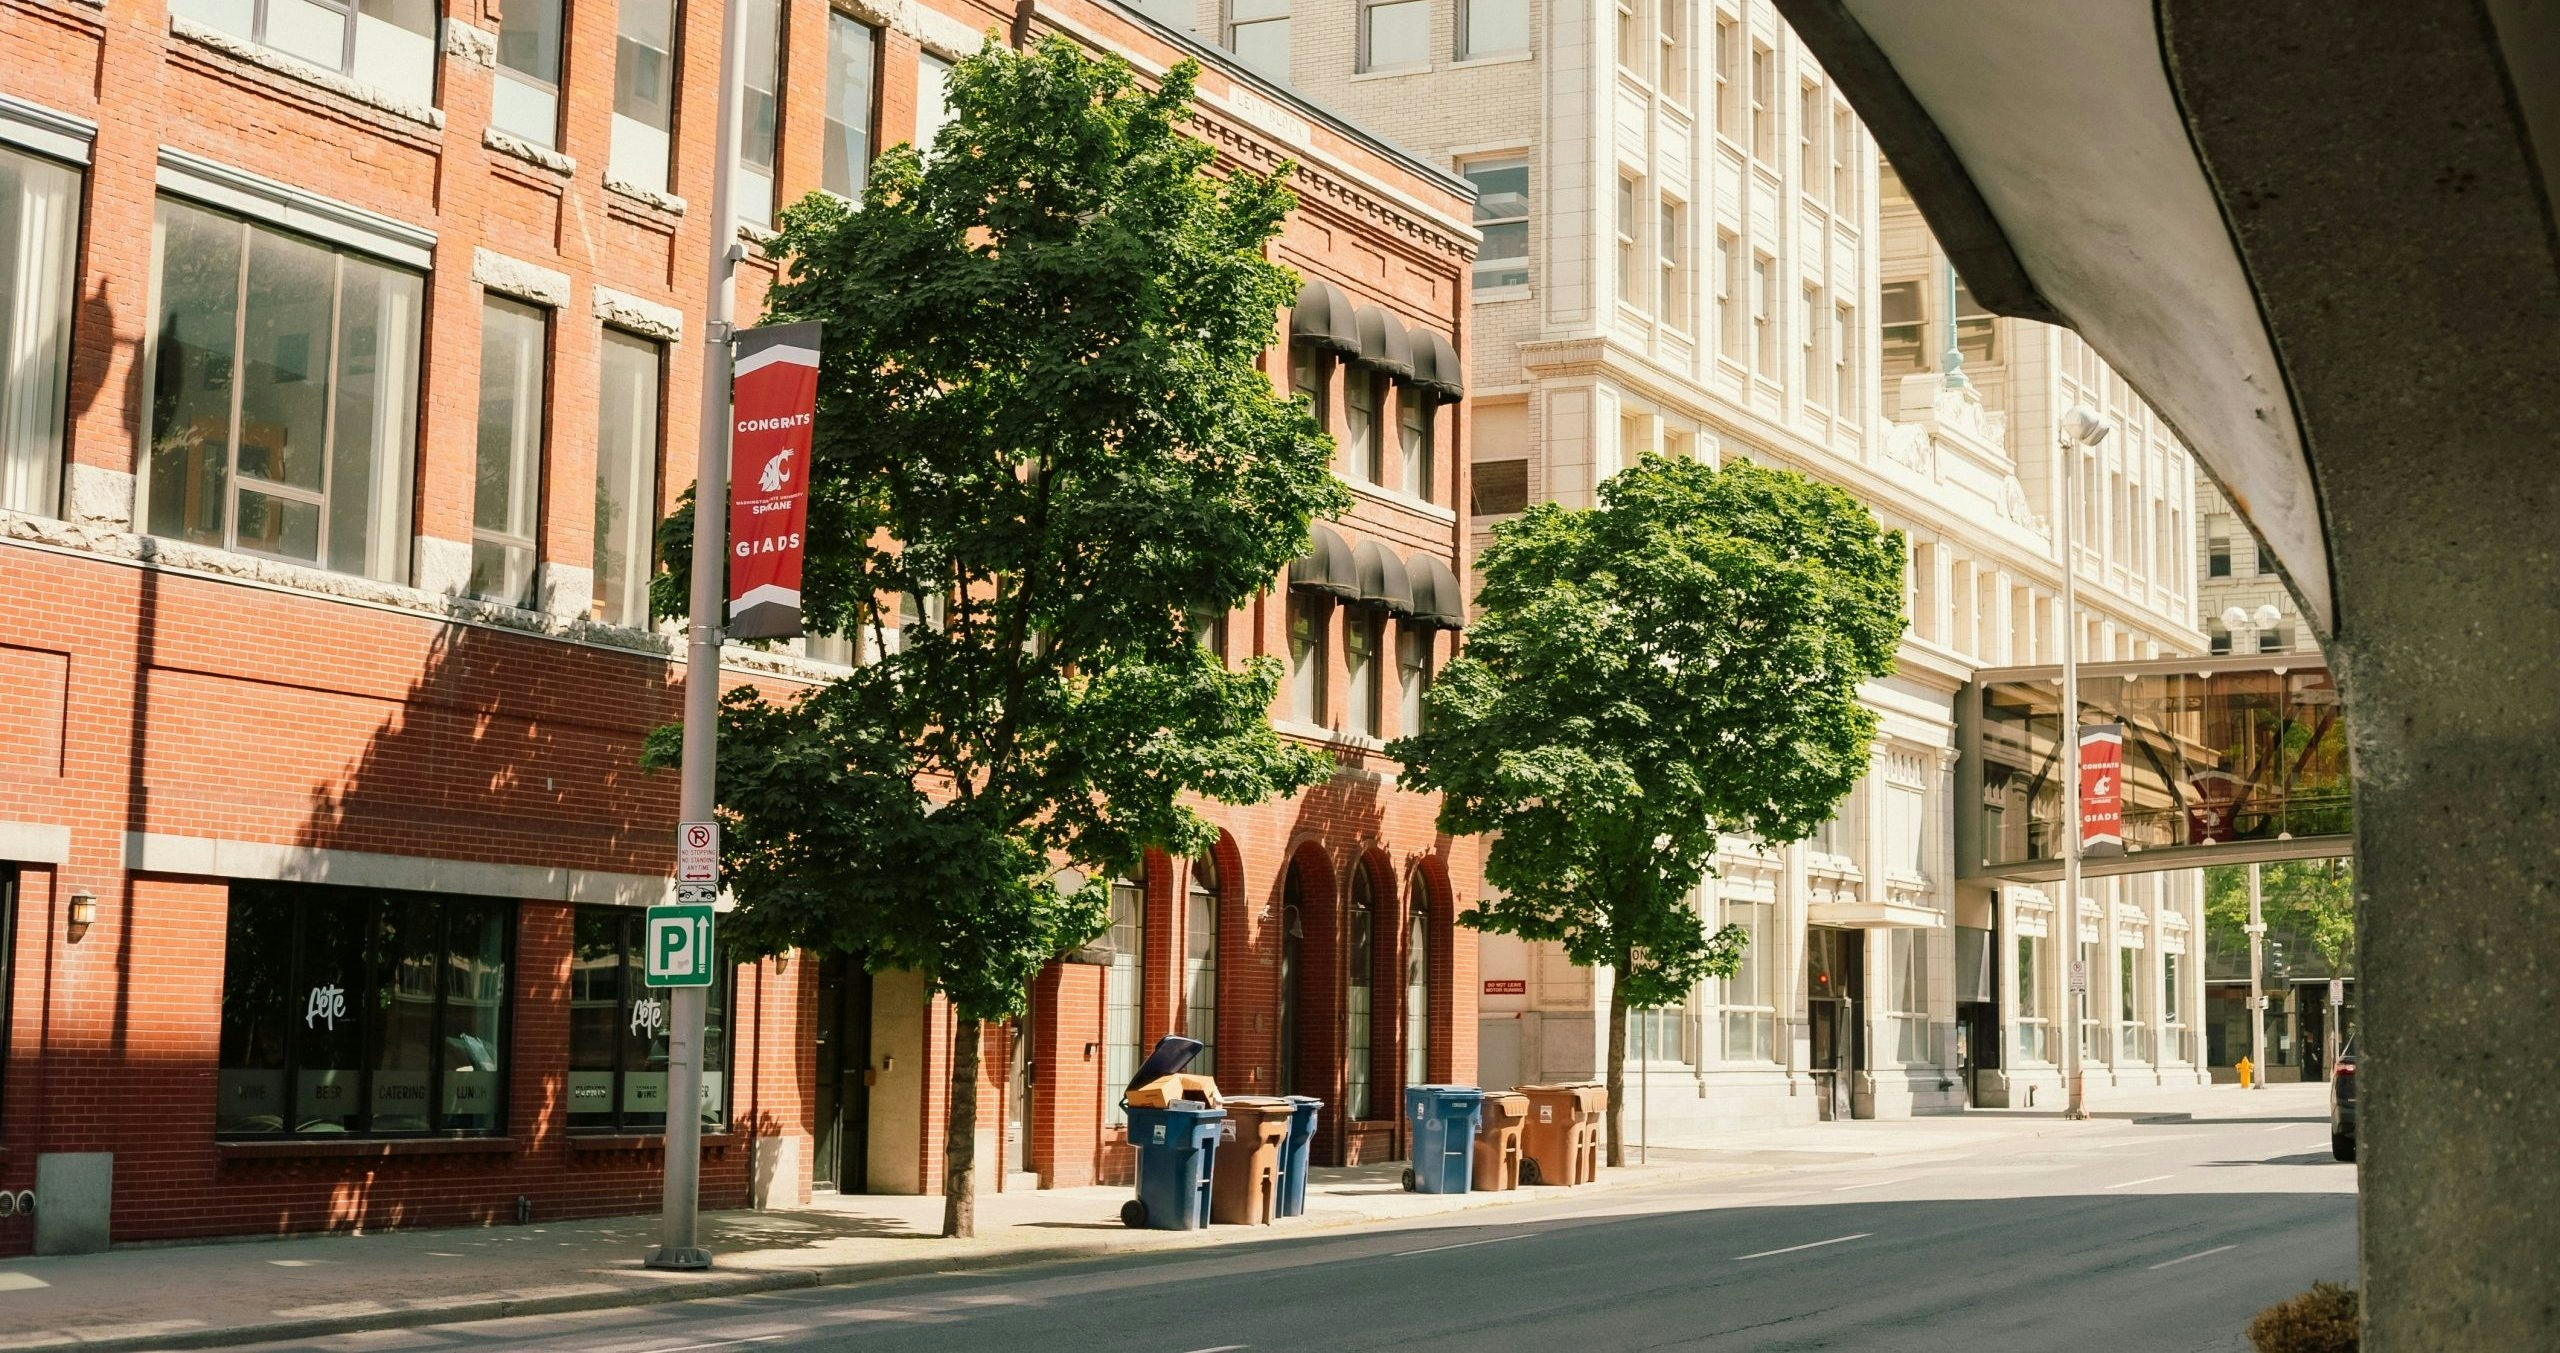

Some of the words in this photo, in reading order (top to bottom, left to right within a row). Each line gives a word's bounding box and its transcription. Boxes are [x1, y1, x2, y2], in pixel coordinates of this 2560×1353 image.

[737, 413, 810, 433] CONGRATS
[660, 925, 687, 970] P
[1632, 950, 1648, 960] ON
[315, 1085, 343, 1100] BEER
[379, 1085, 426, 1100] CATERING
[456, 1085, 488, 1099] LUNCH
